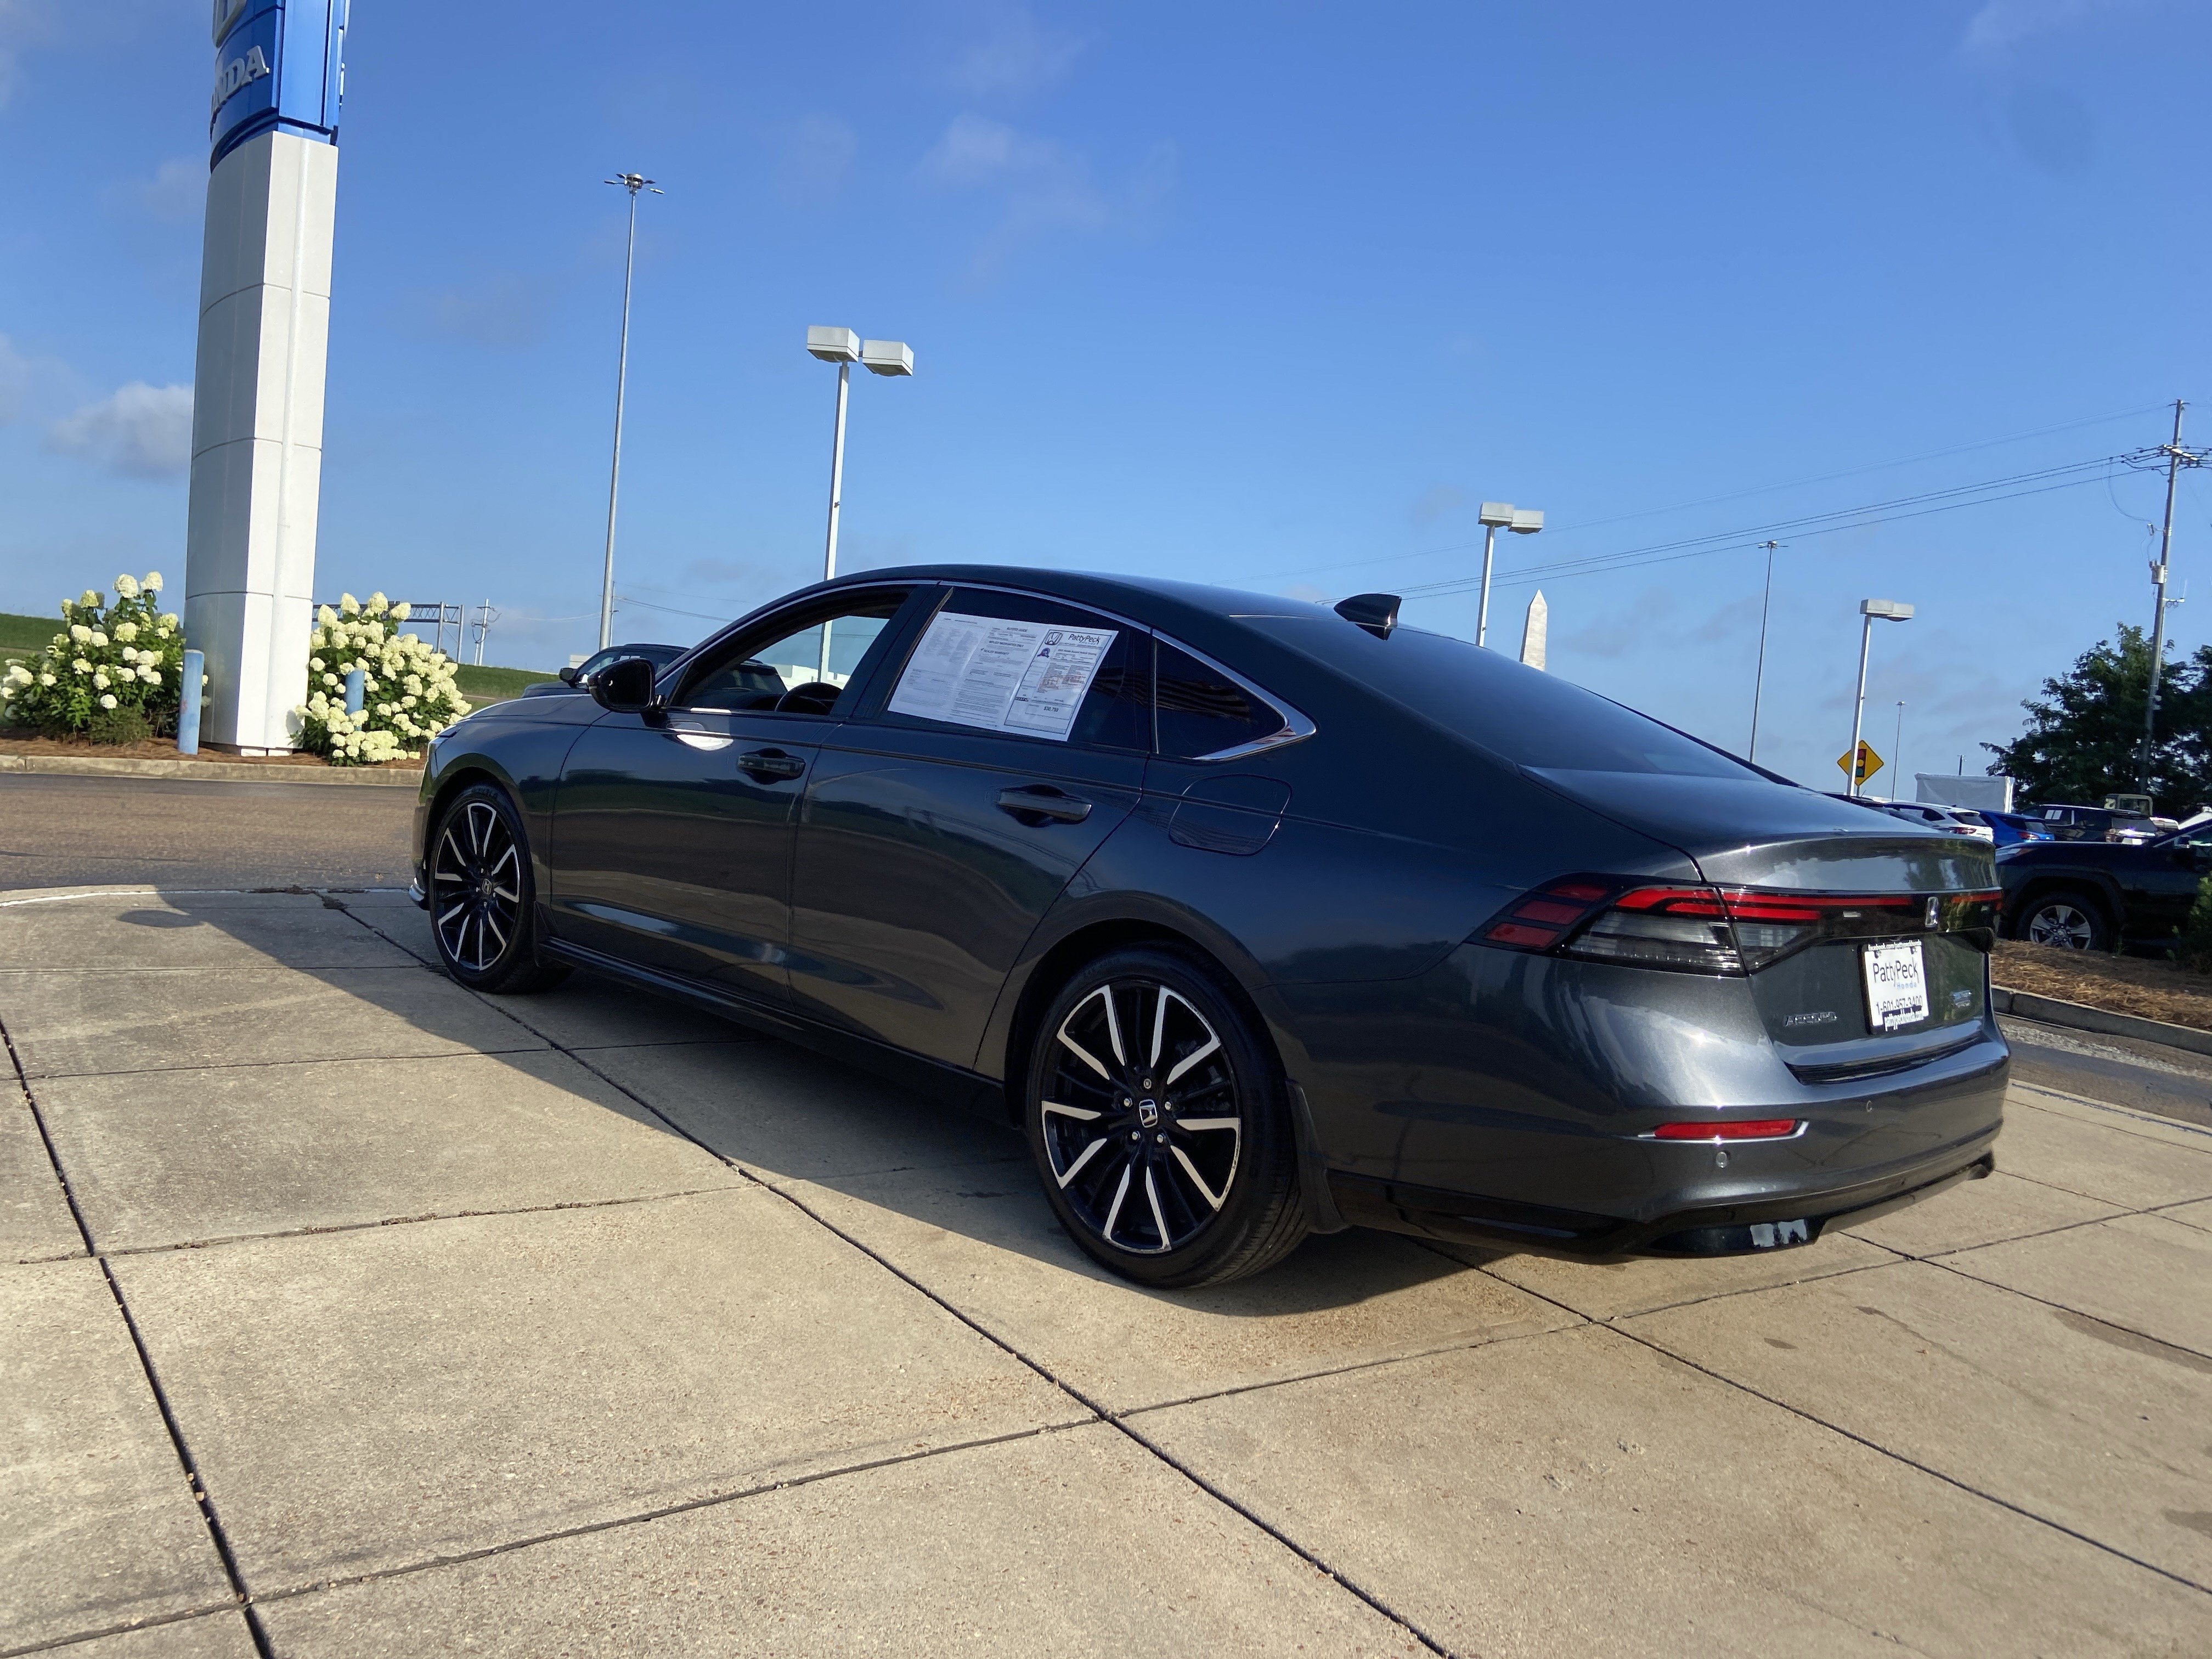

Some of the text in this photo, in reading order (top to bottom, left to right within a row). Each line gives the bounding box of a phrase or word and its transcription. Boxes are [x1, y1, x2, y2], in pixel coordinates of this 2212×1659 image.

[1872, 957, 1919, 987] PattyPeck
[1897, 981, 1917, 990] Honda
[1784, 1011, 1838, 1028] ACCORD
